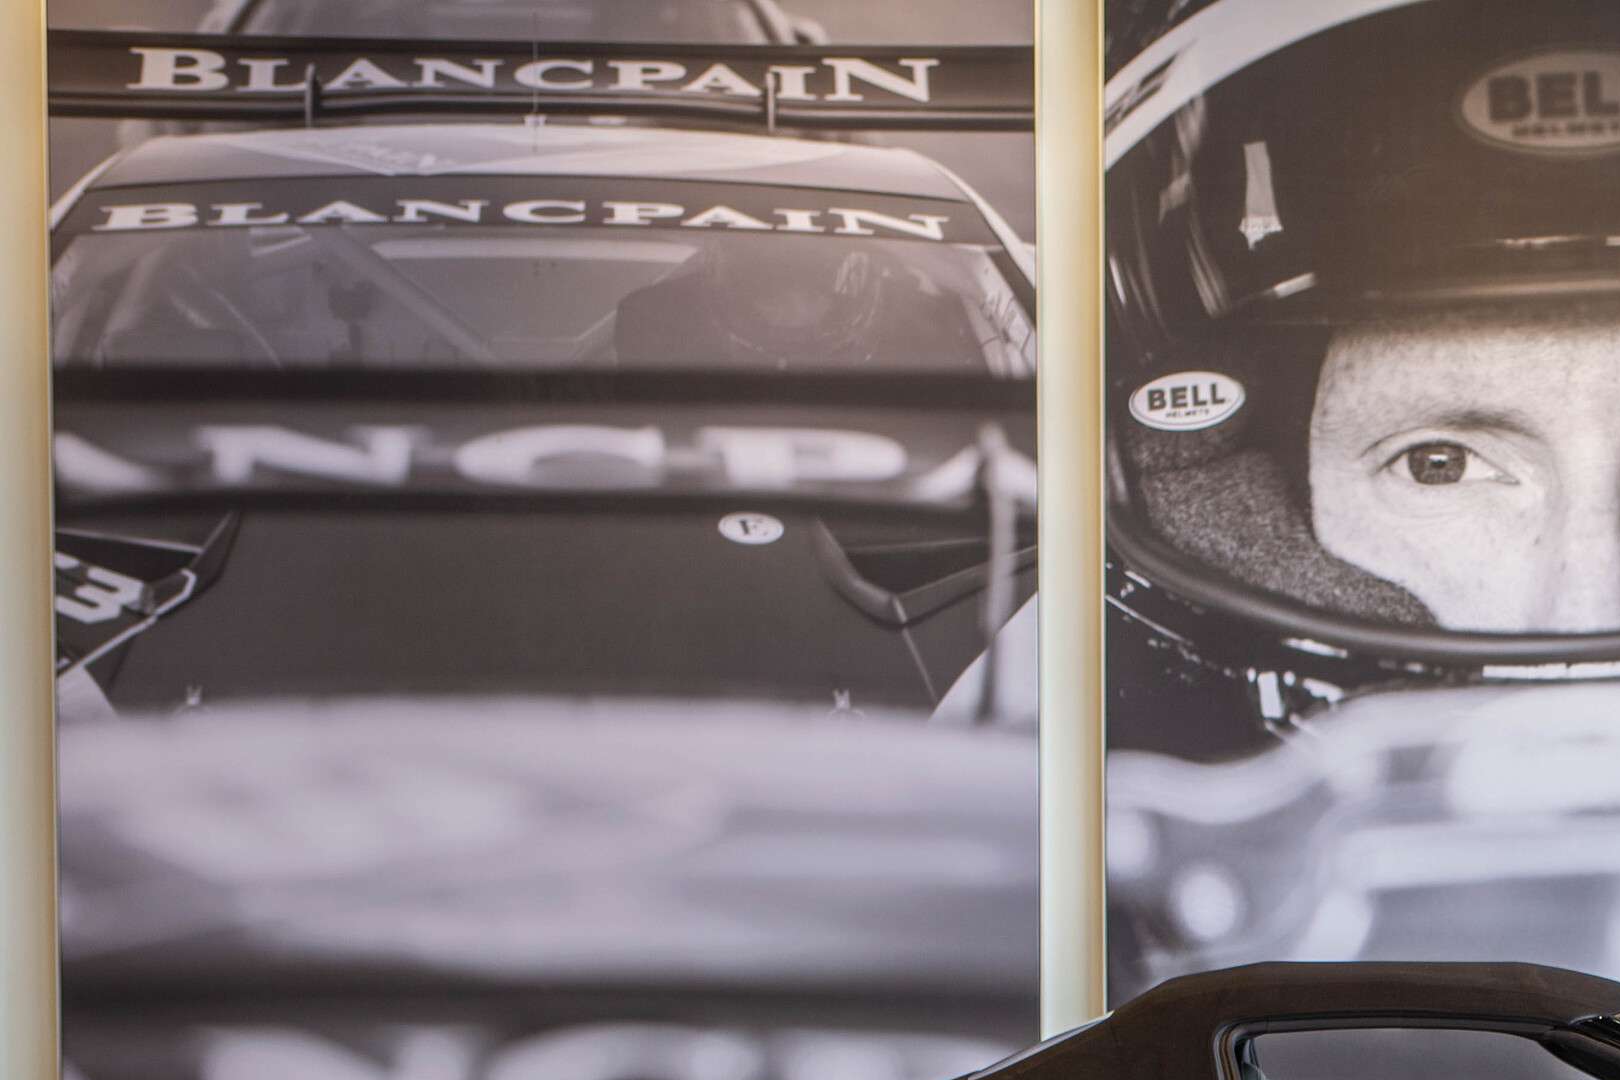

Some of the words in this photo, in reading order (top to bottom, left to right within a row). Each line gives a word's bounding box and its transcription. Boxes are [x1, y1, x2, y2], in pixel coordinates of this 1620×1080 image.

[126, 46, 941, 103] BLANCPAIN
[92, 198, 950, 241] BLANCPAIN
[1146, 382, 1227, 411] BELL
